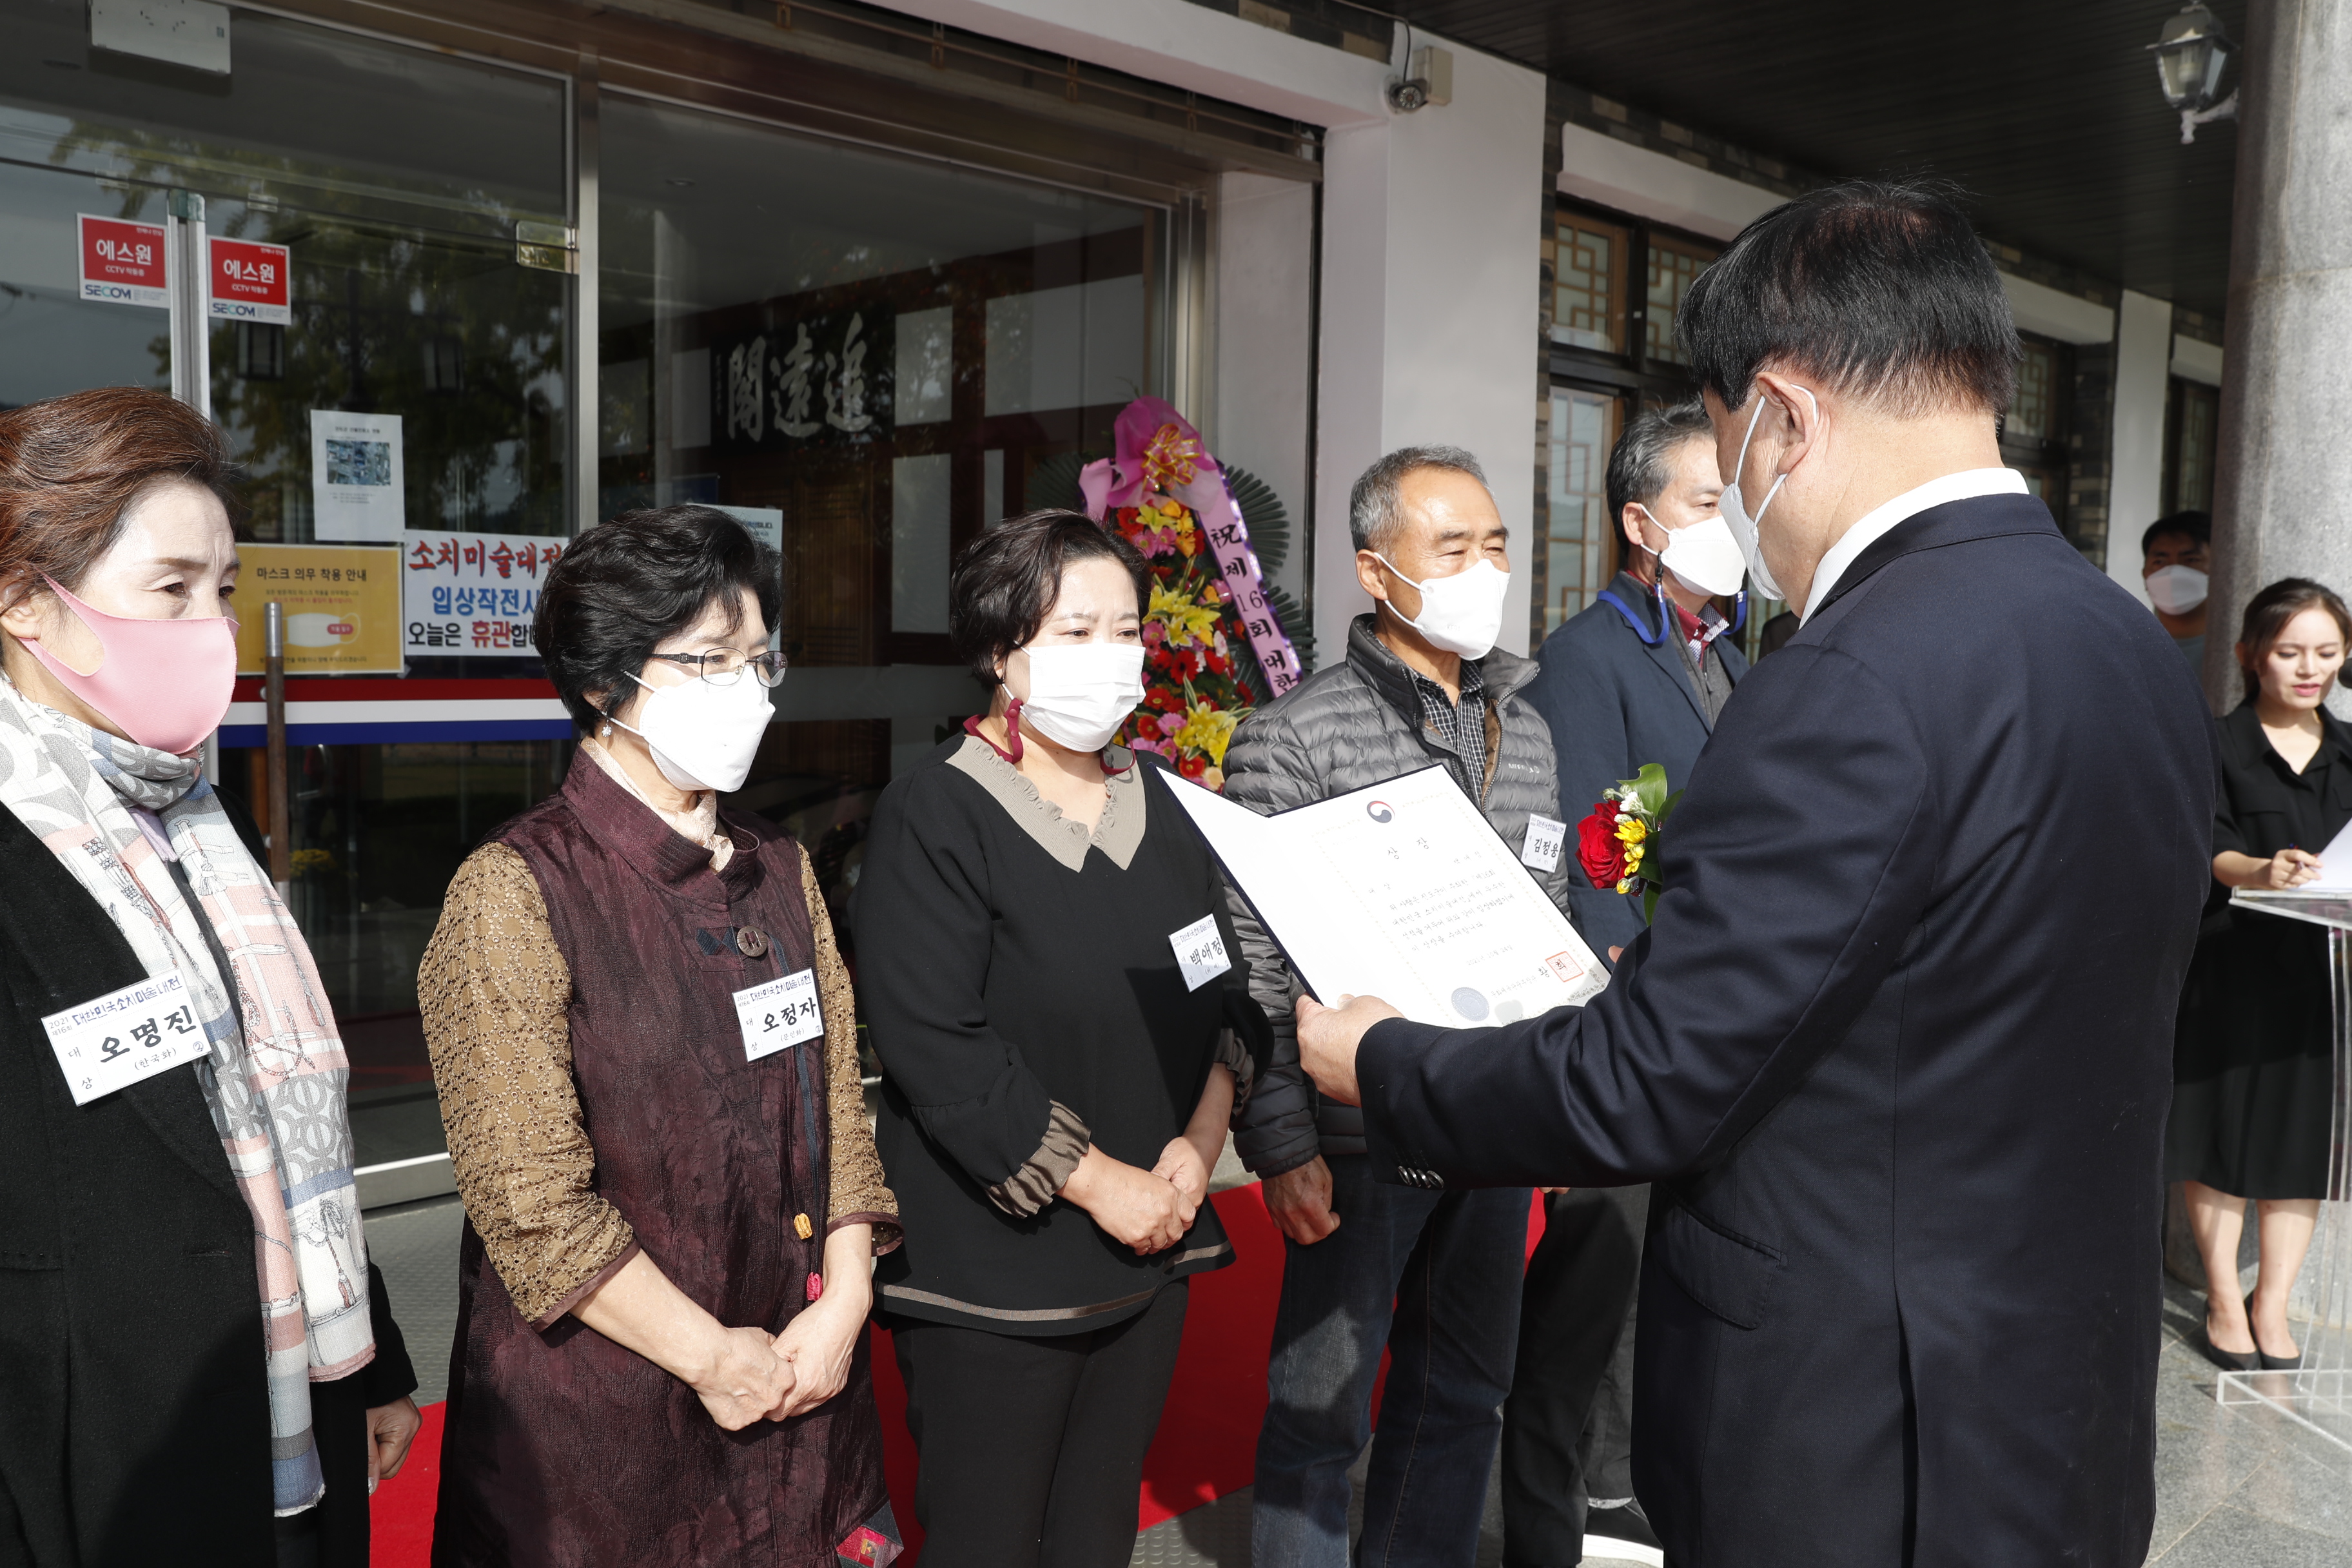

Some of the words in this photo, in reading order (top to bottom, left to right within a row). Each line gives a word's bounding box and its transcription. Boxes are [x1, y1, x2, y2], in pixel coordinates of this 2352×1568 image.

[96, 239, 152, 265] 에스원
[105, 265, 125, 273] CCTV
[223, 259, 274, 284] 에스원
[85, 284, 131, 299] SECOM
[232, 284, 250, 292] CCTV
[213, 302, 255, 317] SECOM
[1210, 524, 1242, 549] 祝
[257, 567, 290, 580] 마스크
[295, 569, 316, 581] 의무
[321, 569, 341, 582] 착용
[346, 569, 367, 582] 안내
[408, 622, 462, 647] 오늘은
[1534, 838, 1558, 858] 김정용
[1389, 903, 1398, 911] 위
[1400, 896, 1420, 908] 사람은
[1421, 885, 1448, 901] 진도군이
[1392, 911, 1422, 926] 대한민국
[1485, 881, 1506, 892] 우수한
[1402, 928, 1424, 940] 성적을
[1424, 919, 1445, 932] 거두어
[1446, 913, 1460, 923] 위와
[1461, 908, 1476, 917] 같이
[1476, 893, 1516, 912] 입상하였기에
[1190, 937, 1222, 966] 백애정
[1423, 935, 1445, 949] 상장을
[1466, 954, 1487, 966] 2021년
[1487, 948, 1499, 959] 10월
[48, 1017, 69, 1030] 2021
[763, 997, 816, 1032] 오정자
[100, 1005, 197, 1063] 오명진
